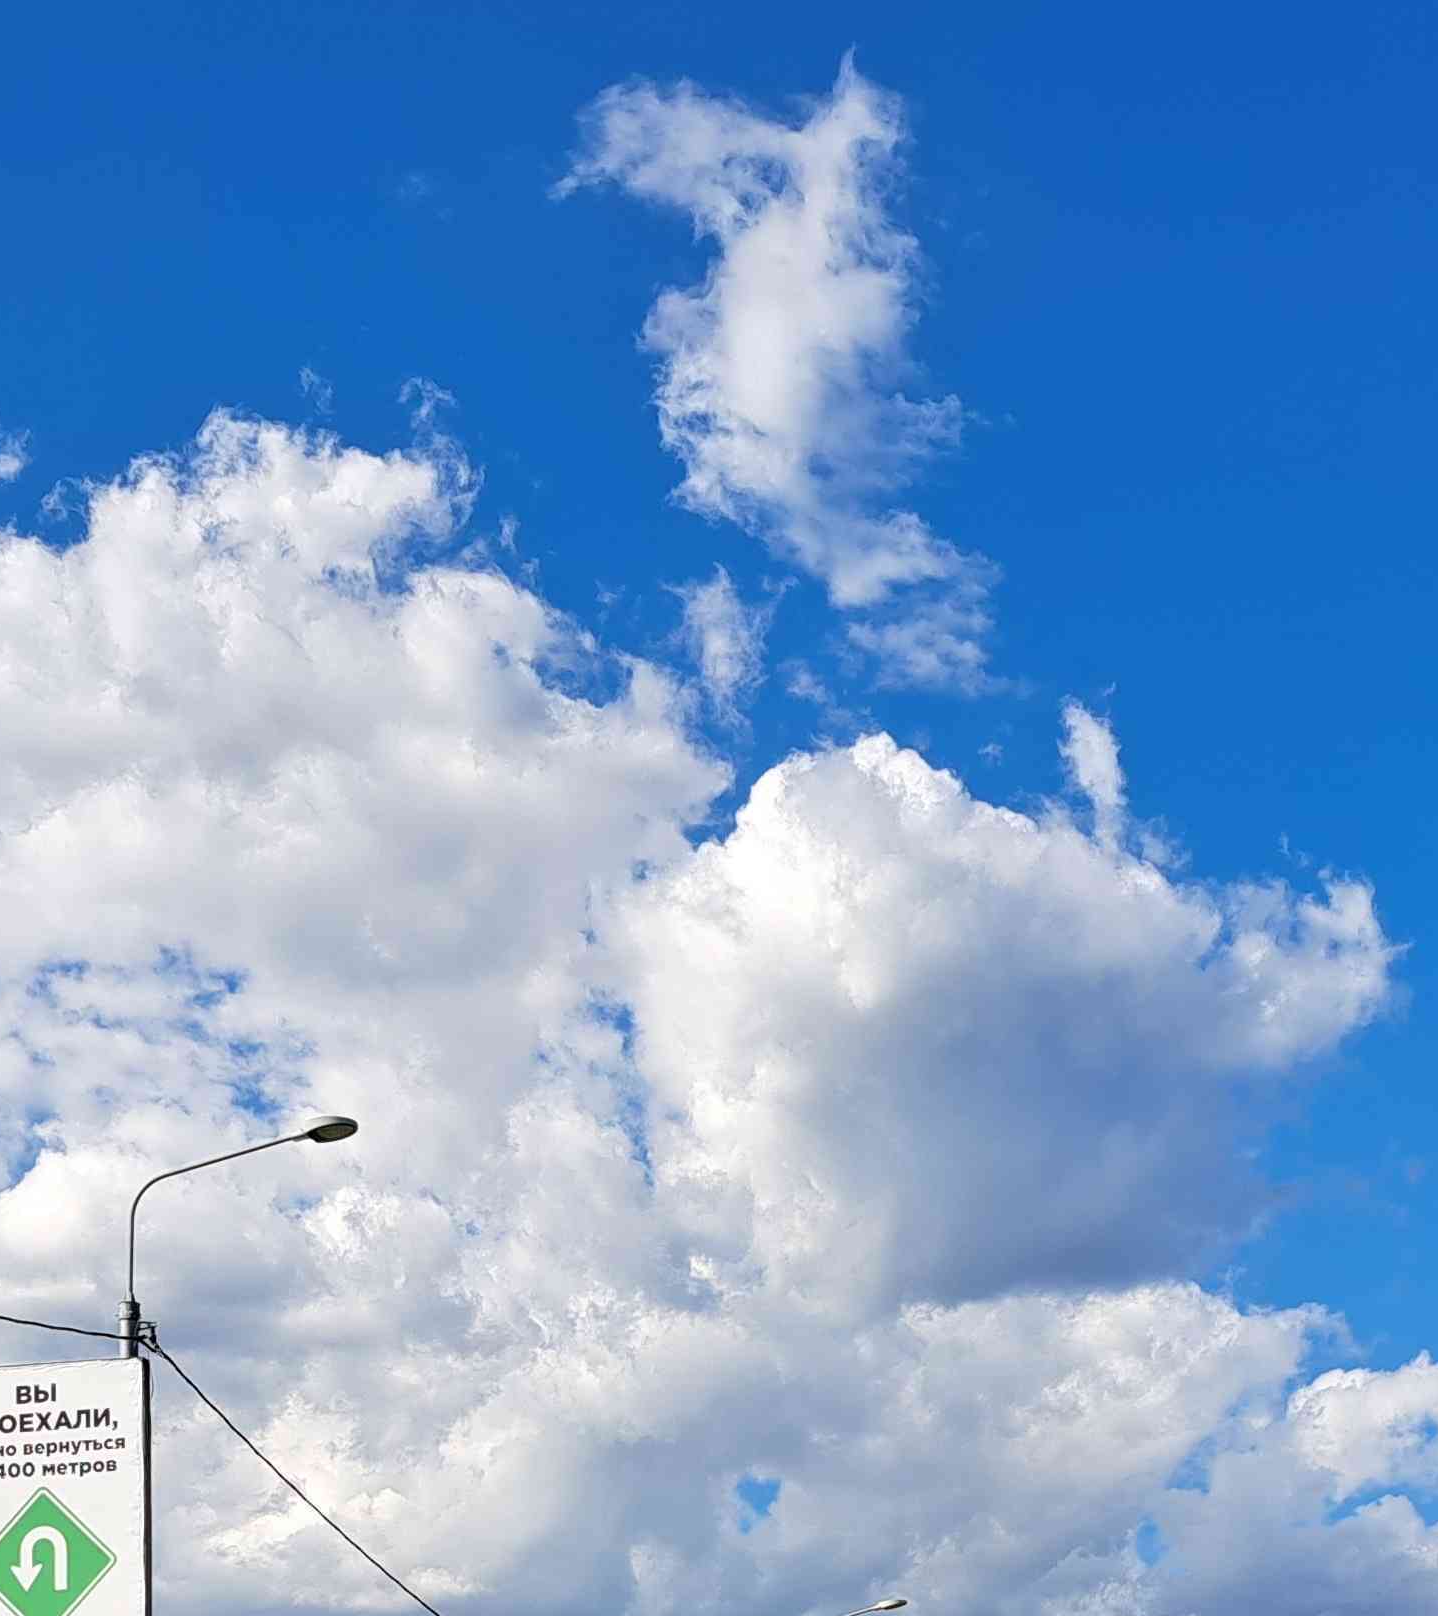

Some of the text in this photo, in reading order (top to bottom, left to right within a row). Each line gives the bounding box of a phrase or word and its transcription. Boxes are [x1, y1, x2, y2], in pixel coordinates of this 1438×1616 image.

[15, 1383, 57, 1405] ВЫ
[23, 1437, 126, 1458] вернуться
[42, 1459, 117, 1480] метров
